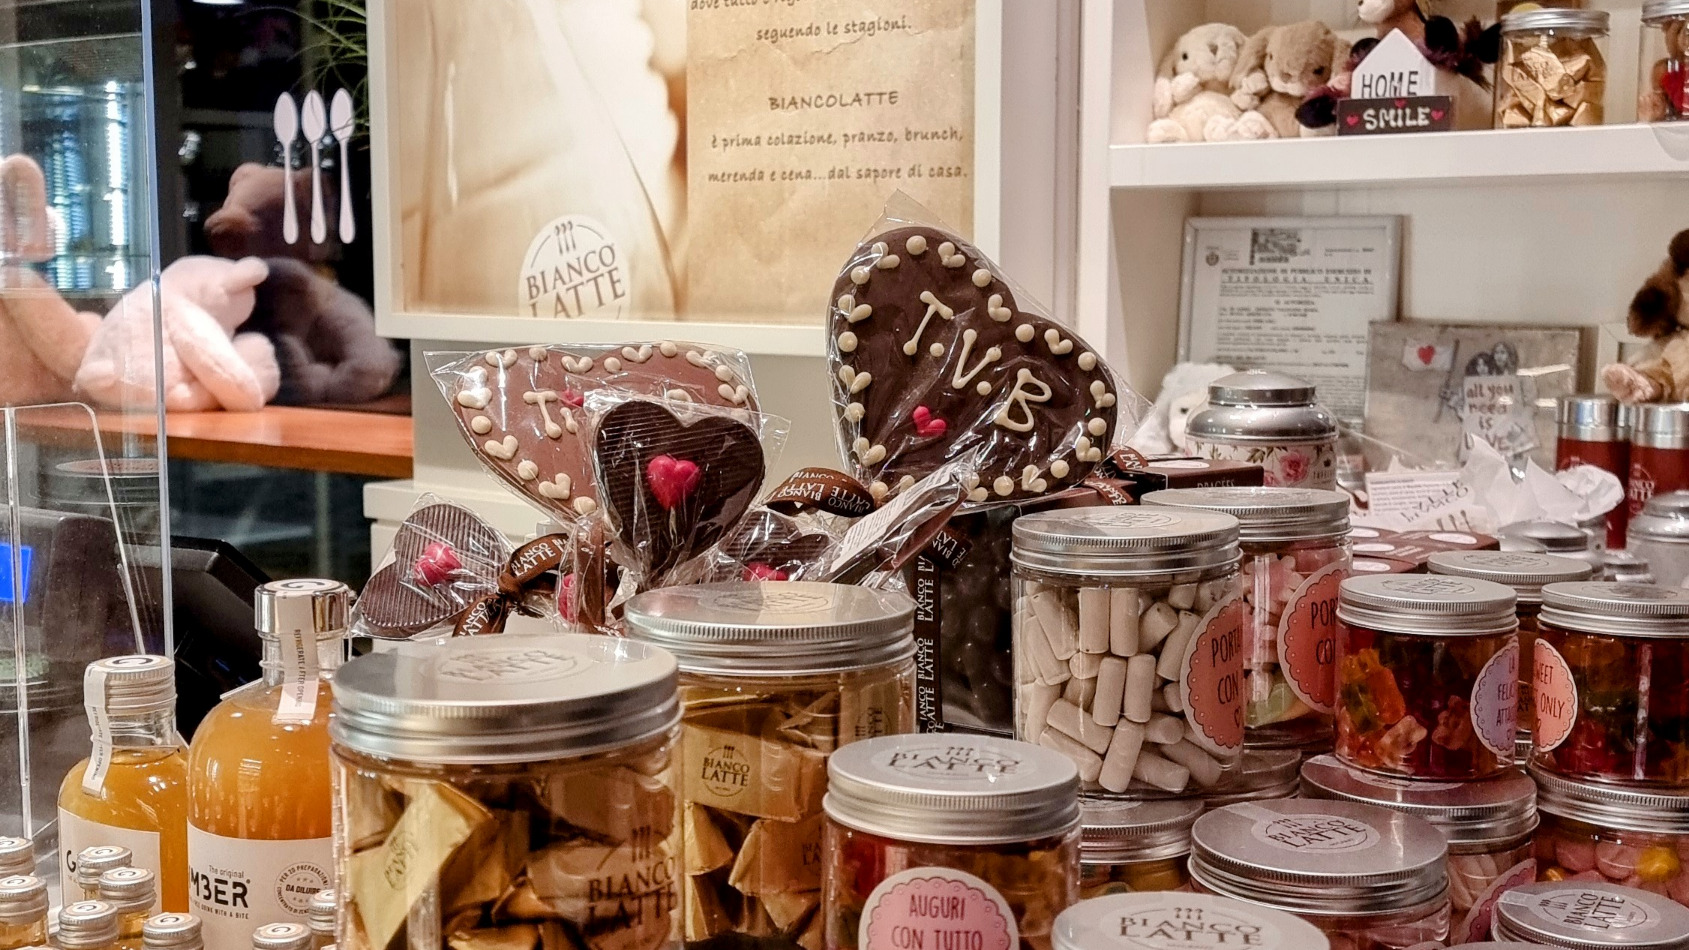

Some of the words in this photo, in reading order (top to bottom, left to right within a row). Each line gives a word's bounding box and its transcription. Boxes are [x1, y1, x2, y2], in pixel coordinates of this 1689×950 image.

[756, 22, 821, 44] seguendo
[826, 21, 840, 35] le
[843, 15, 912, 37] stagioni.
[1361, 70, 1418, 99] HOME
[768, 91, 899, 111] BIANCOLATTE
[1363, 106, 1431, 130] SMILE
[722, 133, 761, 152] prima
[766, 131, 838, 148] colazione,
[842, 129, 898, 150] pranzo,
[904, 126, 963, 143] brunch,
[708, 168, 764, 183] merenda
[856, 167, 901, 184] sapore
[907, 164, 923, 179] di
[928, 165, 968, 179] casa.
[526, 245, 615, 300] BIANCO
[510, 541, 549, 572] BIANCO
[514, 546, 557, 577] LATTE
[917, 578, 925, 621] BIANCO
[925, 579, 934, 622] LATTE
[459, 601, 487, 637] IANCO
[917, 637, 925, 679] BIANCO
[925, 638, 934, 681] LATTE
[1217, 672, 1240, 705] CON
[1540, 692, 1565, 719] ONLY
[701, 767, 749, 787] LATTE
[703, 757, 750, 773] BIANCO
[1267, 819, 1346, 842] BIANCO
[1282, 824, 1367, 848] LATTE
[208, 864, 219, 875] The
[219, 866, 245, 879] original
[909, 894, 966, 921] AUGURI
[1563, 892, 1599, 925] BIANCO
[1584, 896, 1626, 929] LATTE
[891, 926, 924, 950] CON
[934, 929, 983, 950] TUTTO
[1119, 925, 1263, 946] LATTE
[1120, 916, 1262, 935] BIANCO
